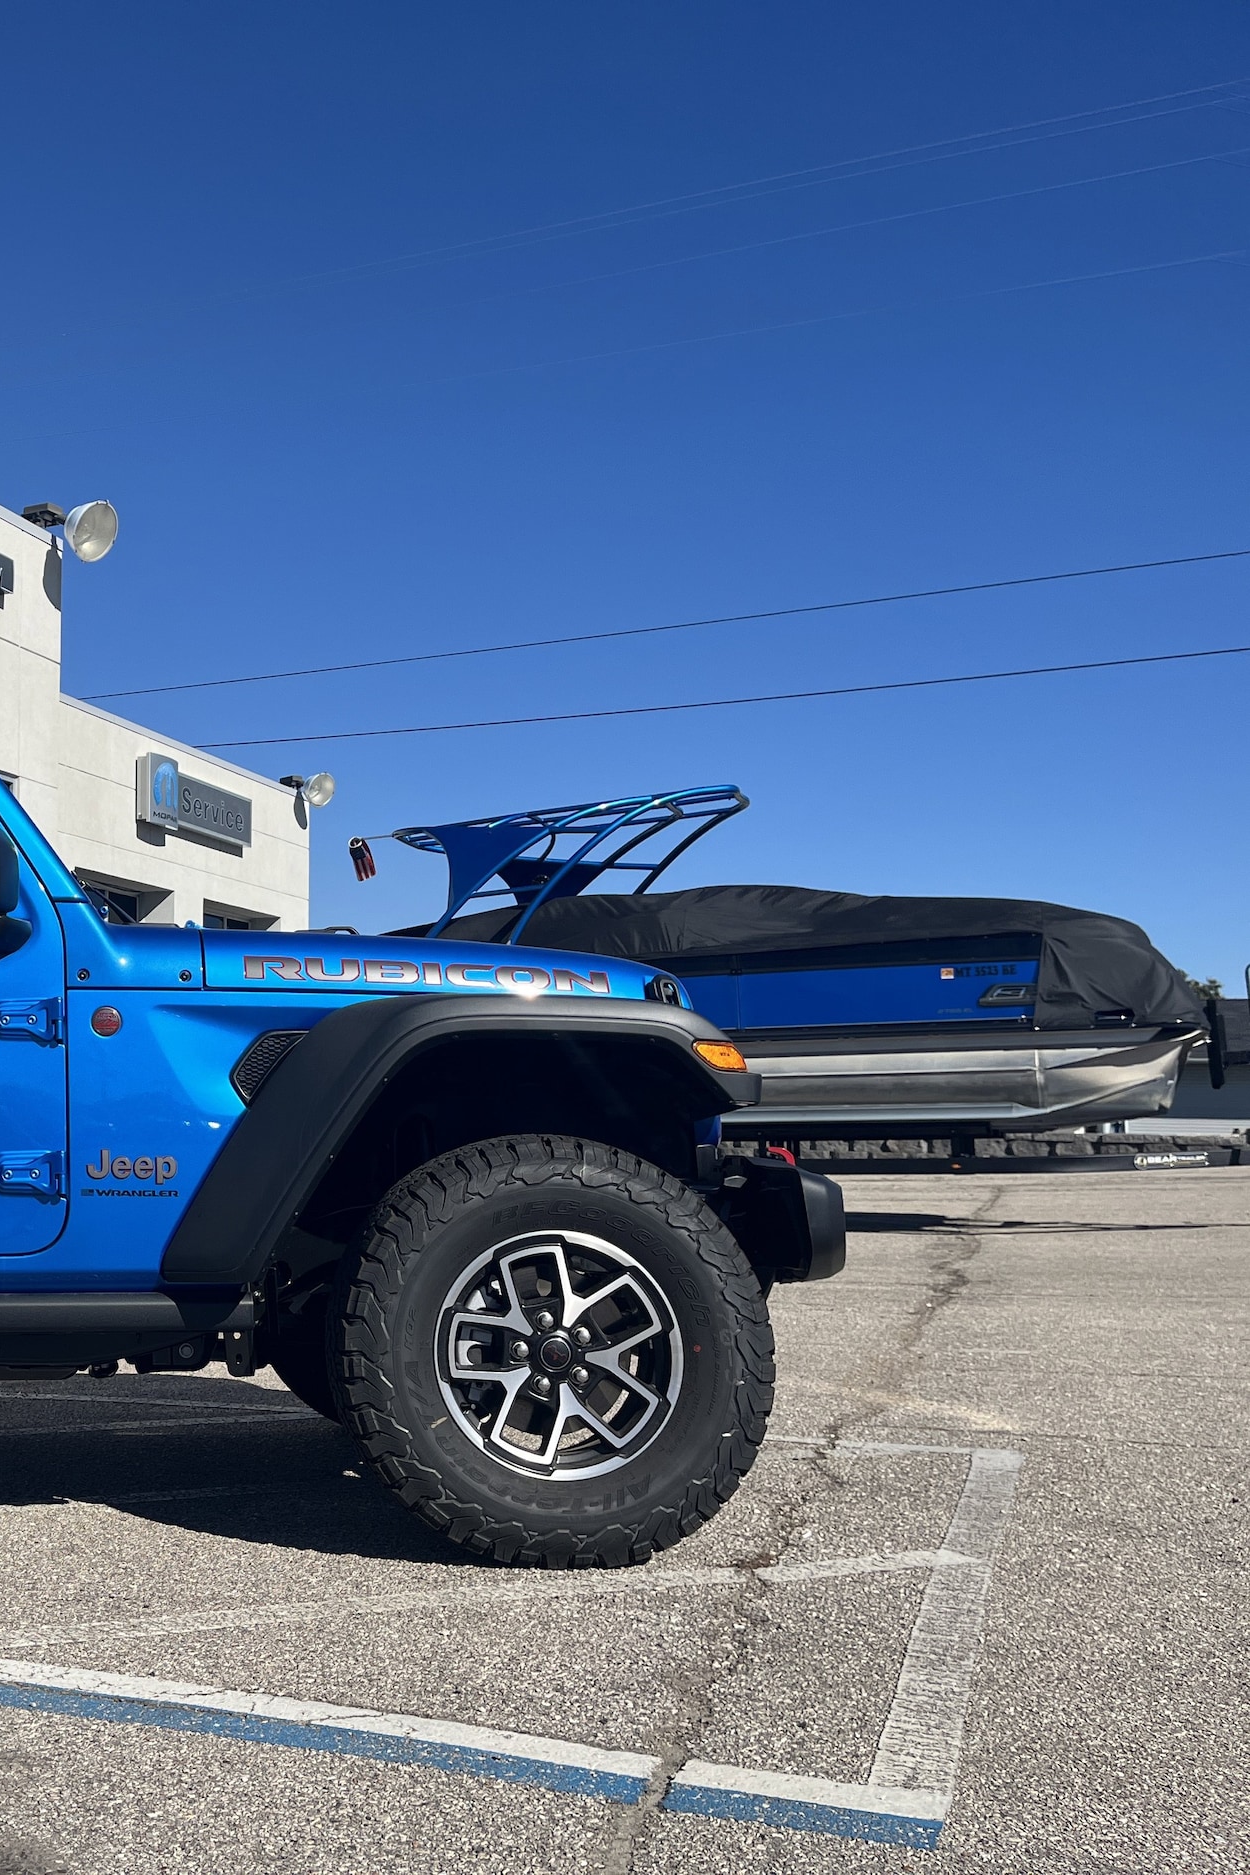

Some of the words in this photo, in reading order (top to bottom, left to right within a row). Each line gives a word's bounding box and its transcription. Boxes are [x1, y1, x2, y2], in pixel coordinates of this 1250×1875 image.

[181, 786, 245, 833] Service
[243, 955, 612, 994] RUBICON
[86, 1149, 178, 1185] Jeep
[95, 1189, 179, 1198] WRANGLER
[492, 1199, 711, 1326] BFGoodrich
